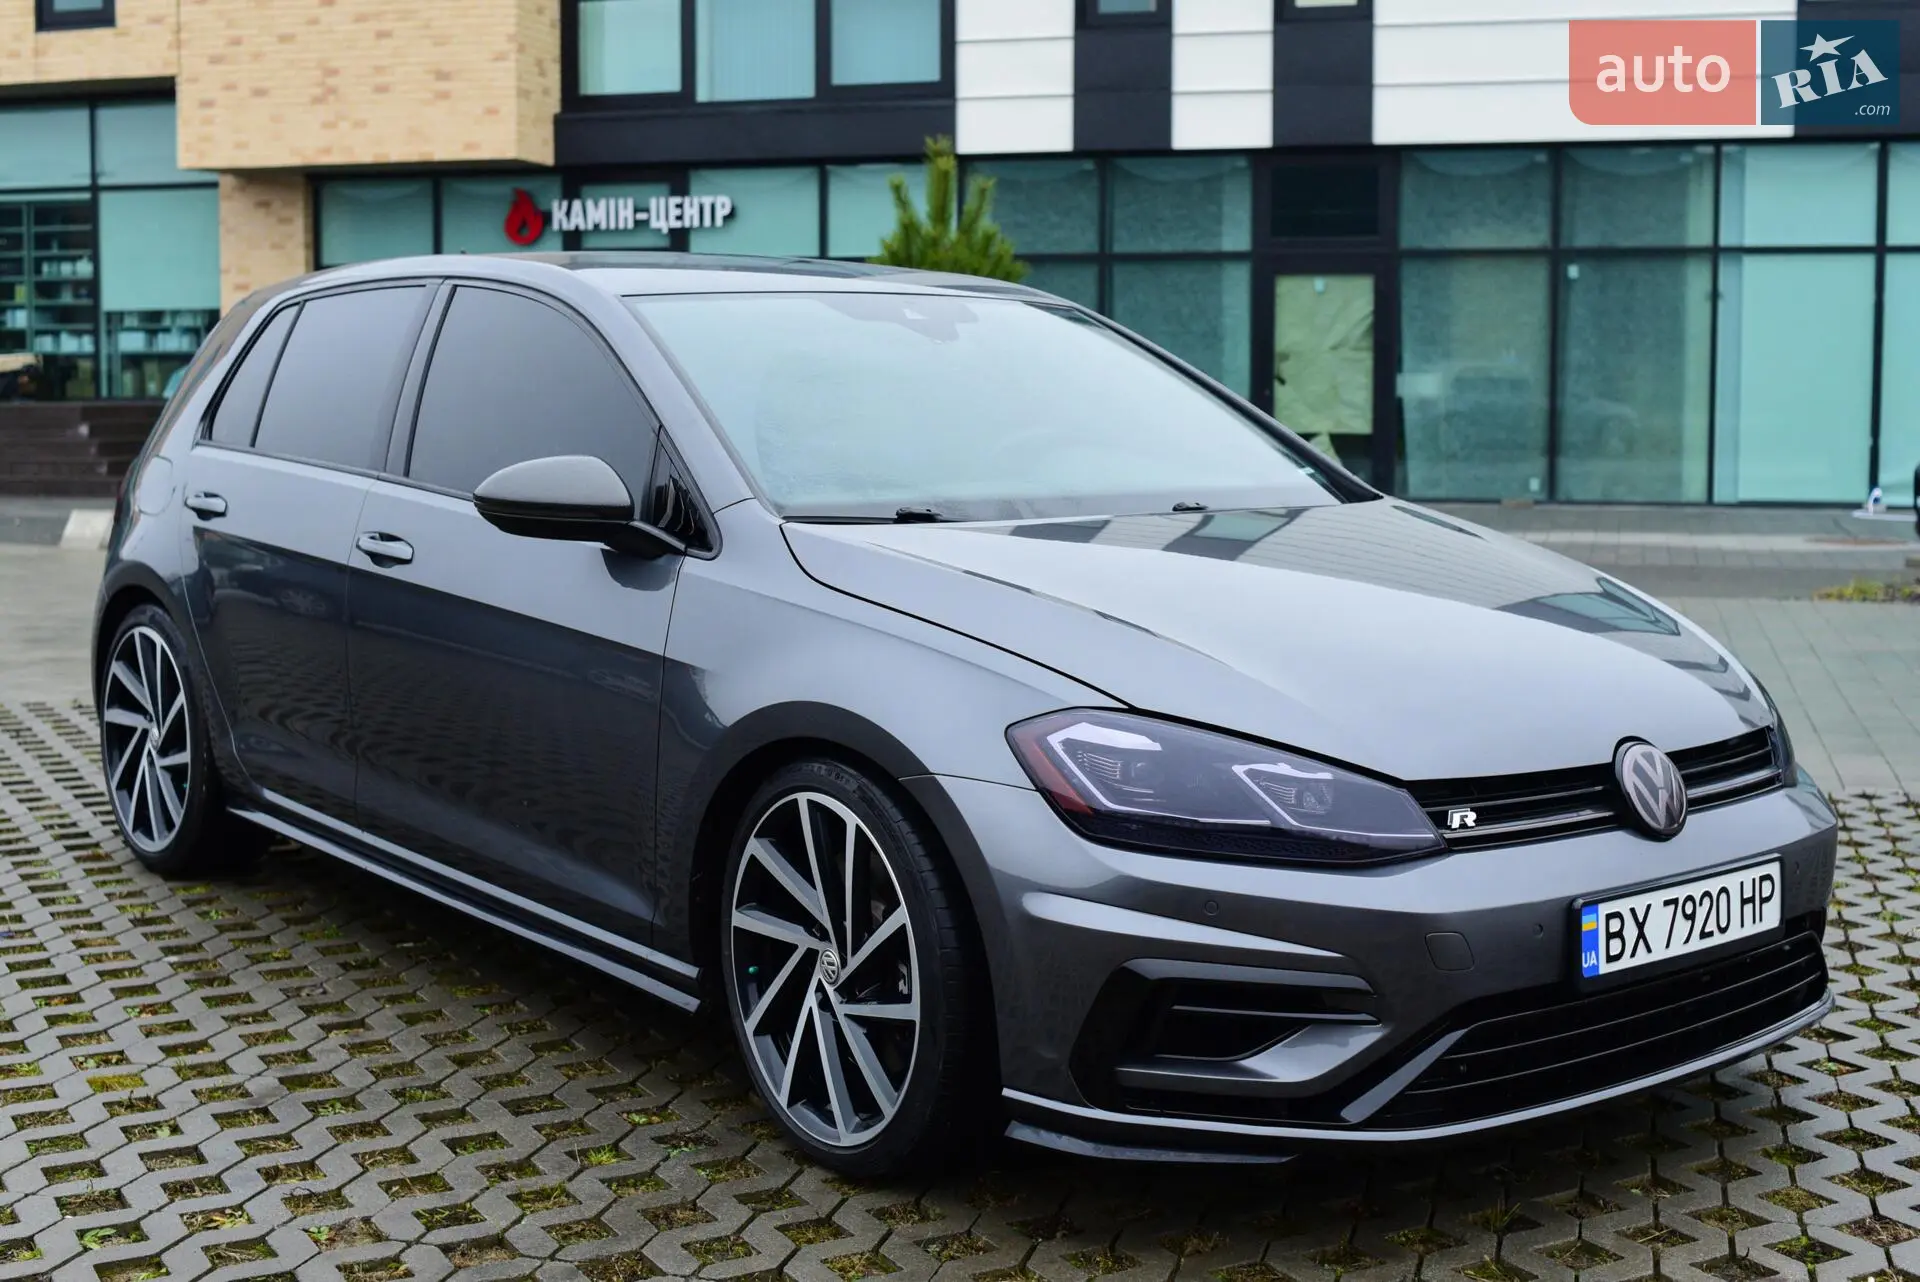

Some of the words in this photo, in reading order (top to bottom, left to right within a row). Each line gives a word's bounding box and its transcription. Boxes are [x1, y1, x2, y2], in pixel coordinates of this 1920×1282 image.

[552, 195, 732, 234] КАМІН-ЦЕНТР
[1447, 808, 1477, 829] R
[1605, 903, 1653, 964] BX
[1663, 885, 1731, 950] 7920
[1740, 873, 1775, 928] HP
[1582, 951, 1598, 968] UA
